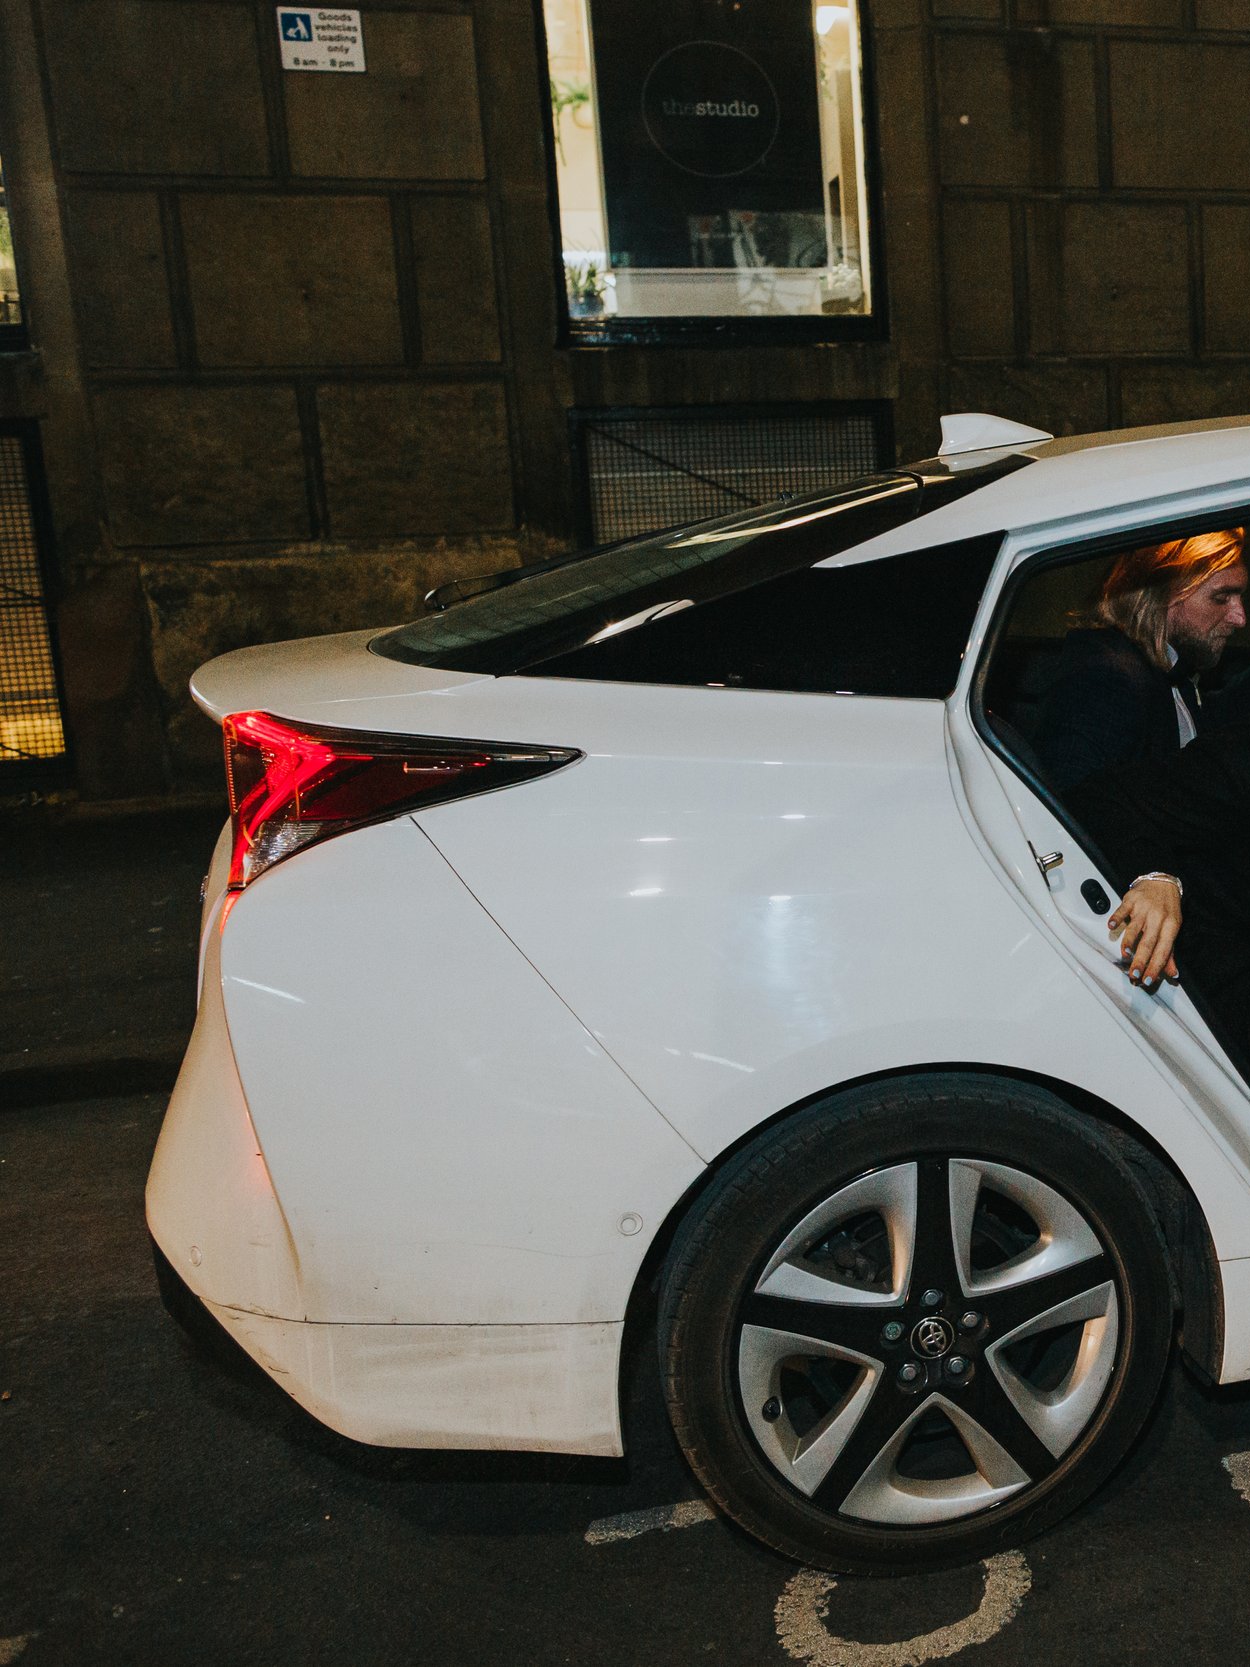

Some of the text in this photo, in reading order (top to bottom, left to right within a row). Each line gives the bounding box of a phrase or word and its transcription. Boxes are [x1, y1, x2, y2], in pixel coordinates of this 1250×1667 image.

[318, 12, 352, 21] Goods
[315, 23, 358, 32] vehicles
[317, 34, 357, 44] loading
[327, 45, 349, 54] only
